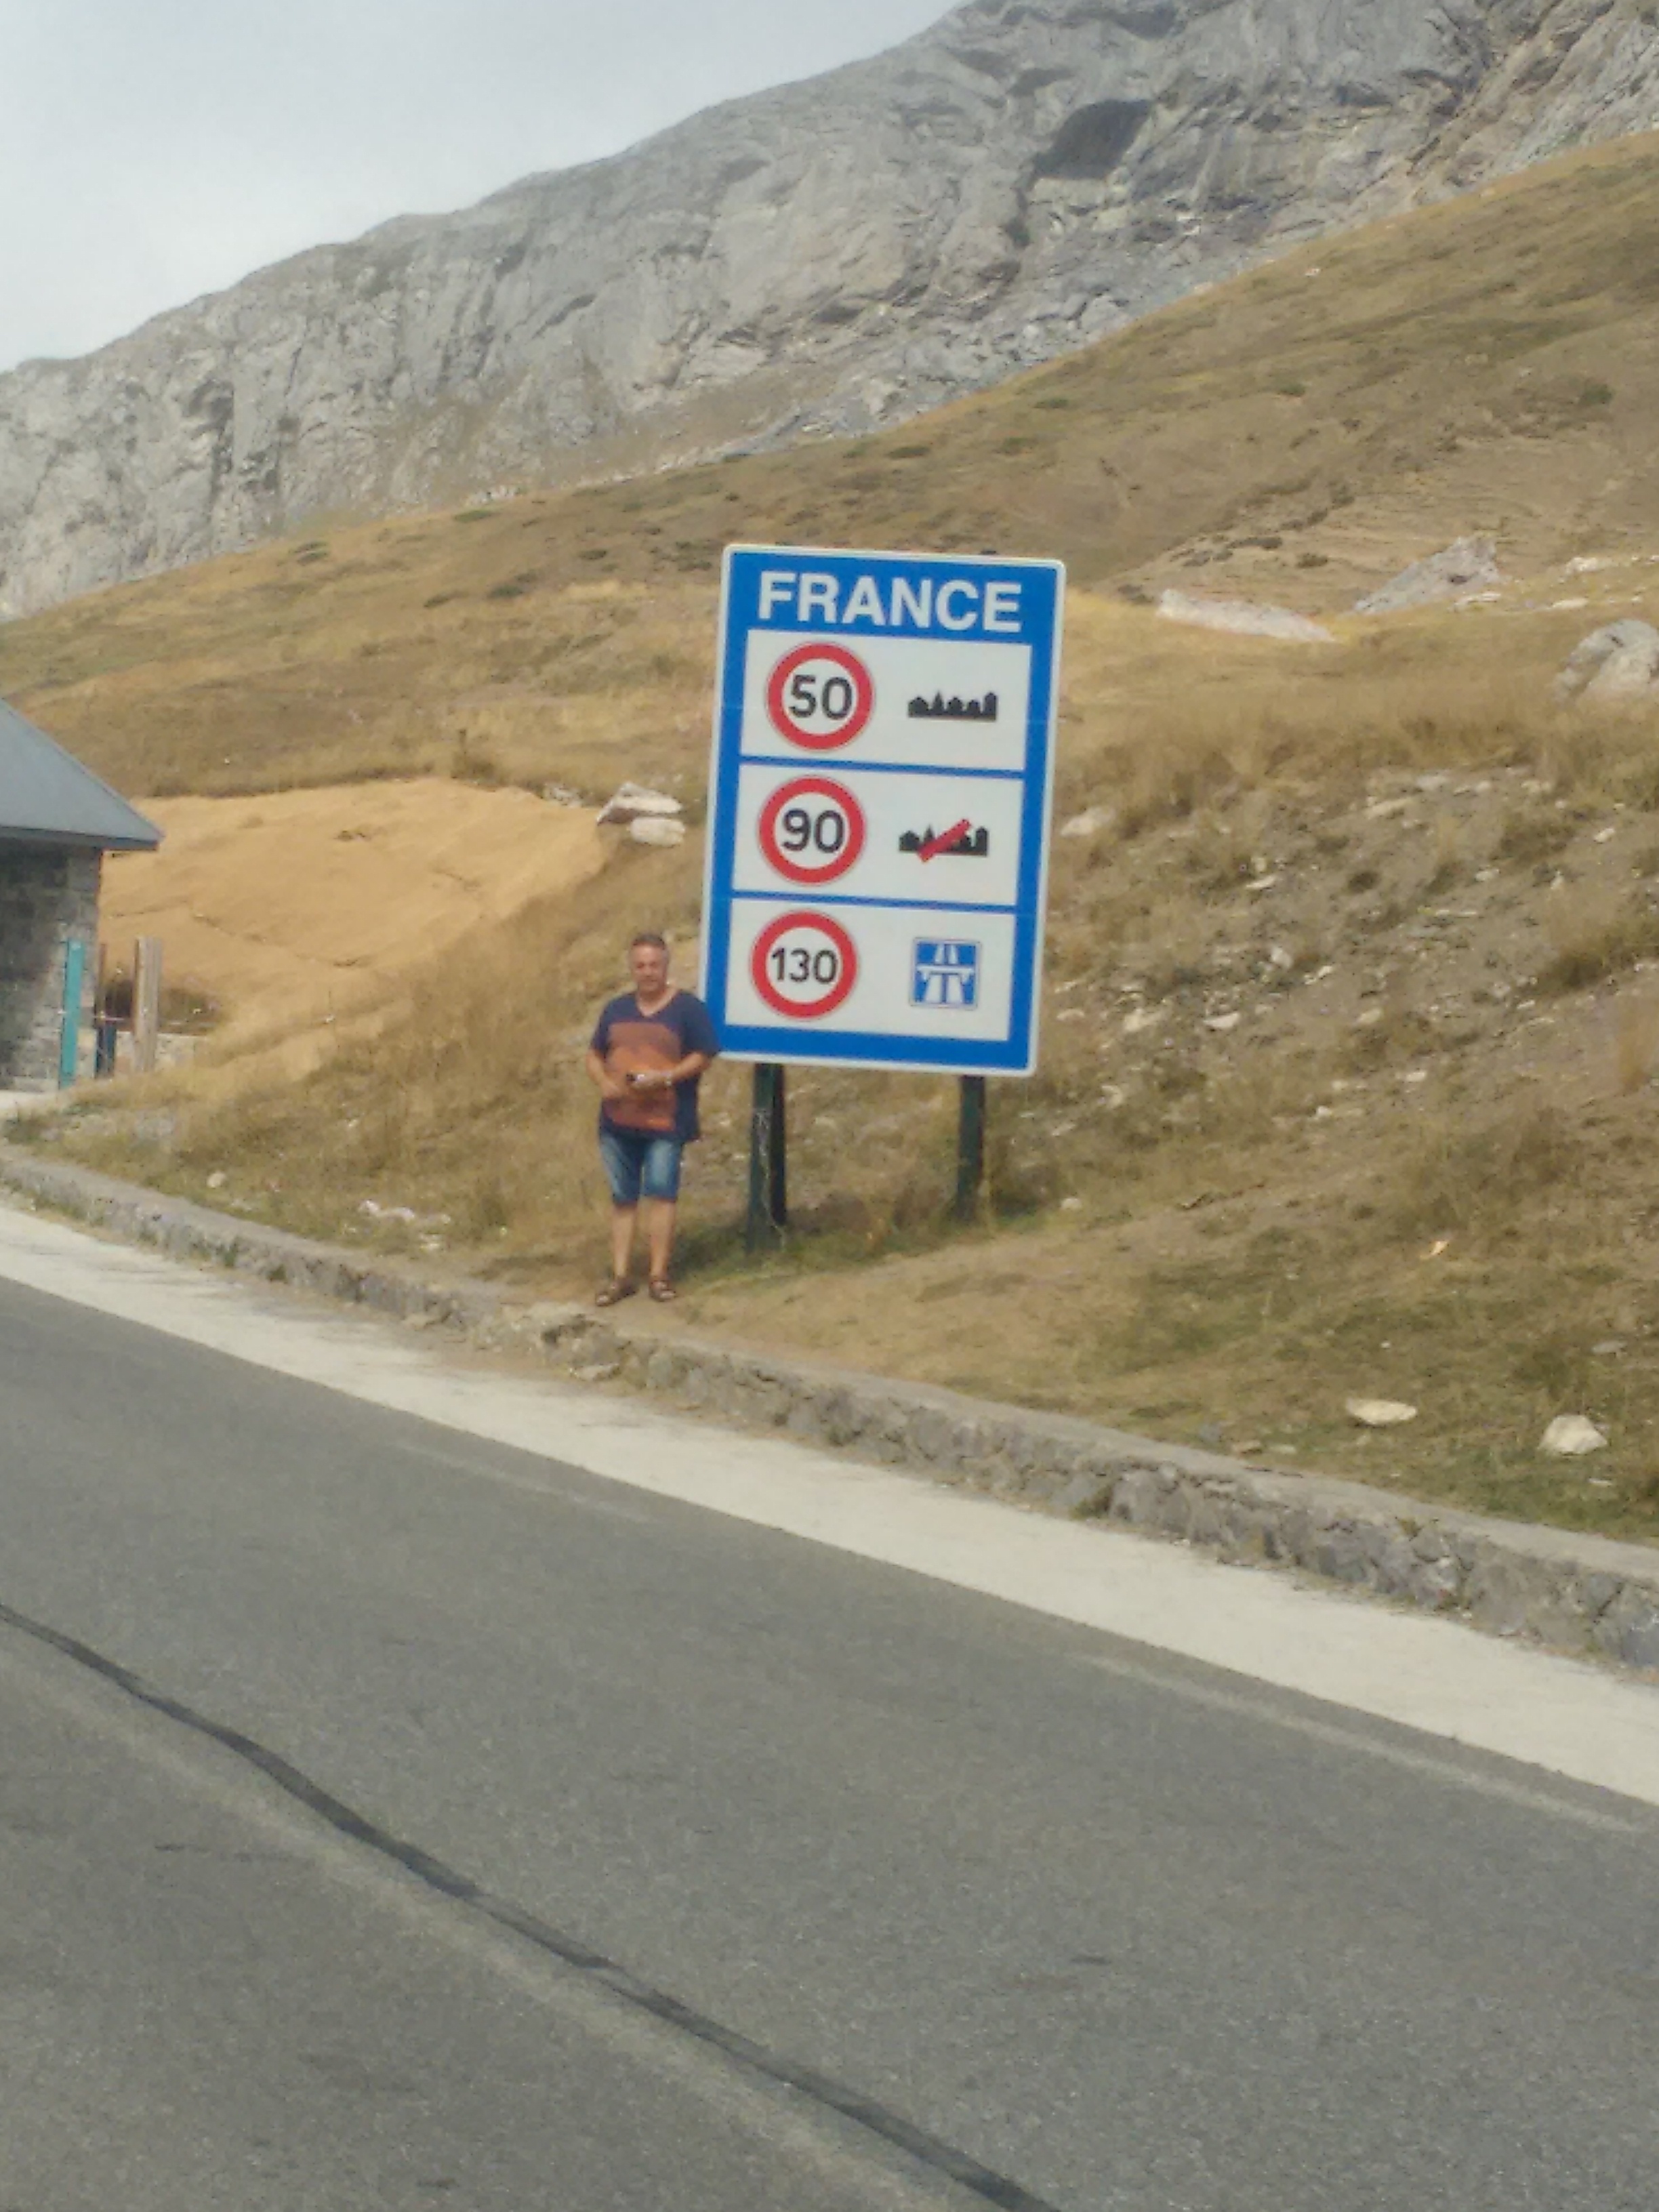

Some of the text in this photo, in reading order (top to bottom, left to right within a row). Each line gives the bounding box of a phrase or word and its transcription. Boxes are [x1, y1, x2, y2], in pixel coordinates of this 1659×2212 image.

[758, 571, 1021, 632] FRANCE
[788, 674, 853, 720] 50
[781, 808, 845, 854] 90
[771, 949, 839, 984] 130
